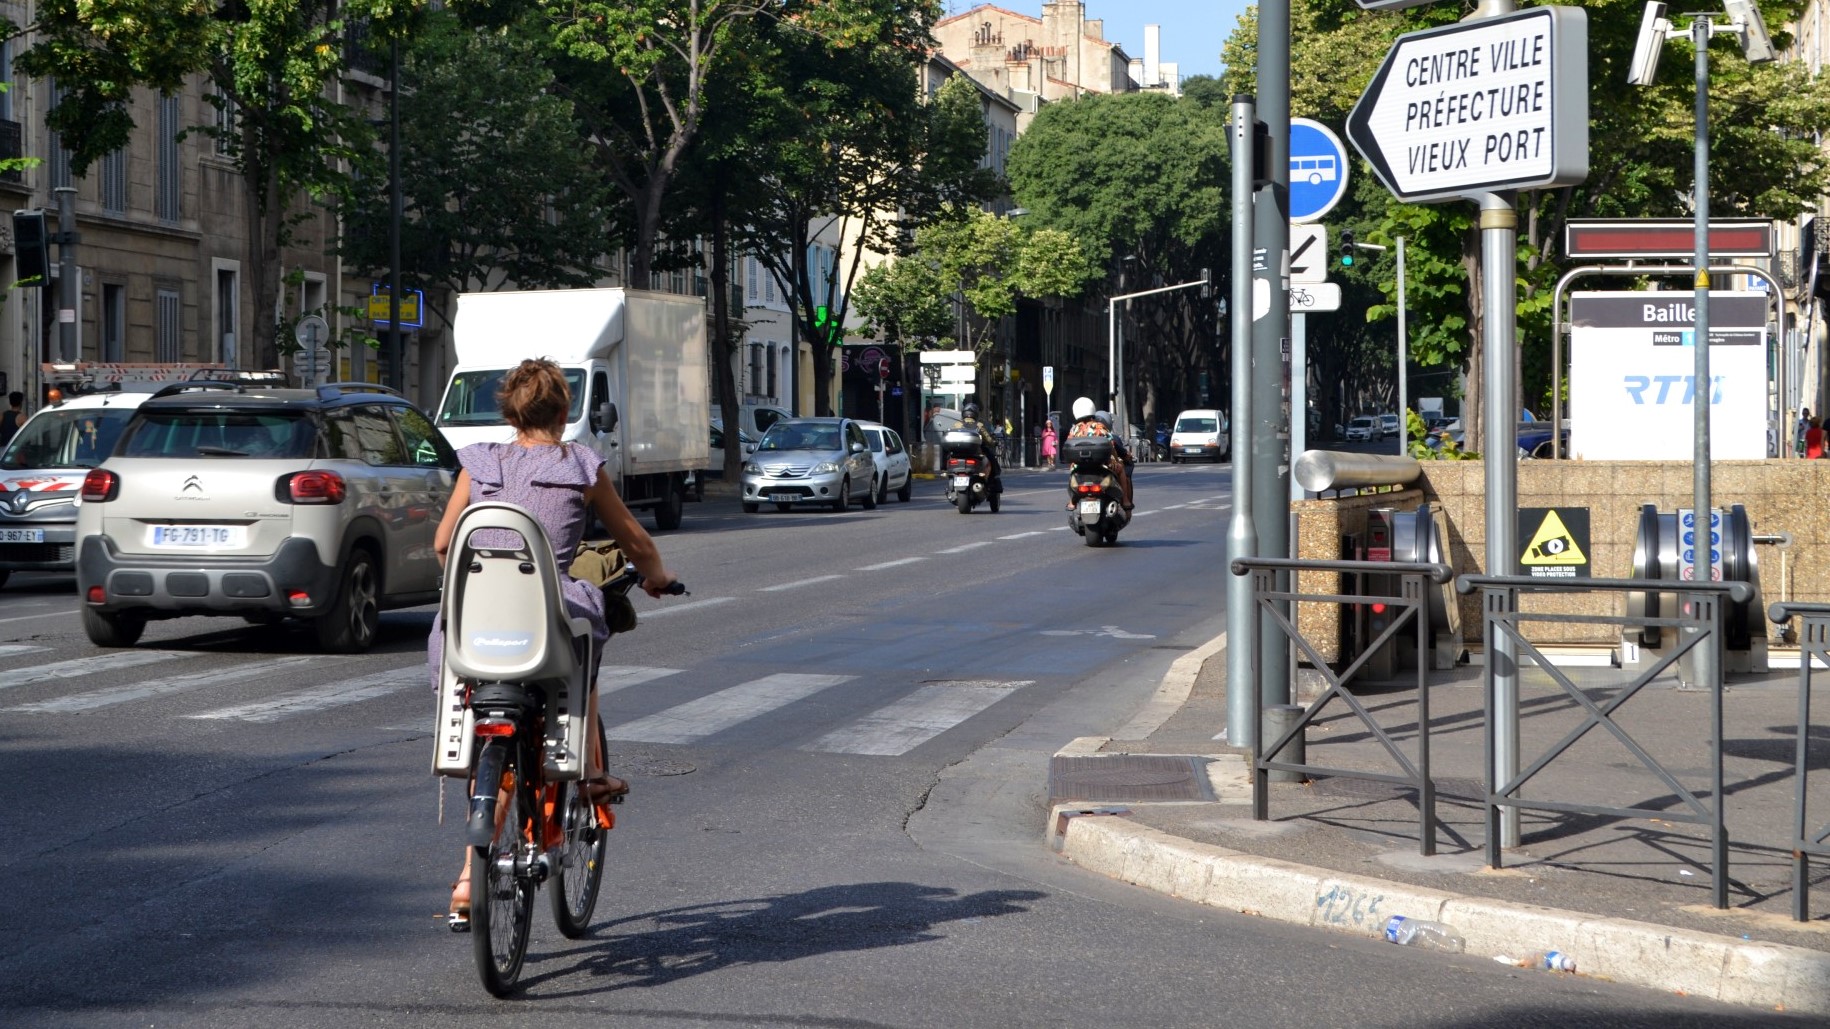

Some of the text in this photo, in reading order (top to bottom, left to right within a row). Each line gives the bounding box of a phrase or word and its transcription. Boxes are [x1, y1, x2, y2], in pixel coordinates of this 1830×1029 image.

[1406, 34, 1544, 87] CENTRE VILLE
[1405, 81, 1544, 132] PRÉFECTURE
[1408, 126, 1545, 175] VIEUX PORT
[1654, 334, 1680, 343] Métro
[163, 528, 229, 543] FG-791-TG
